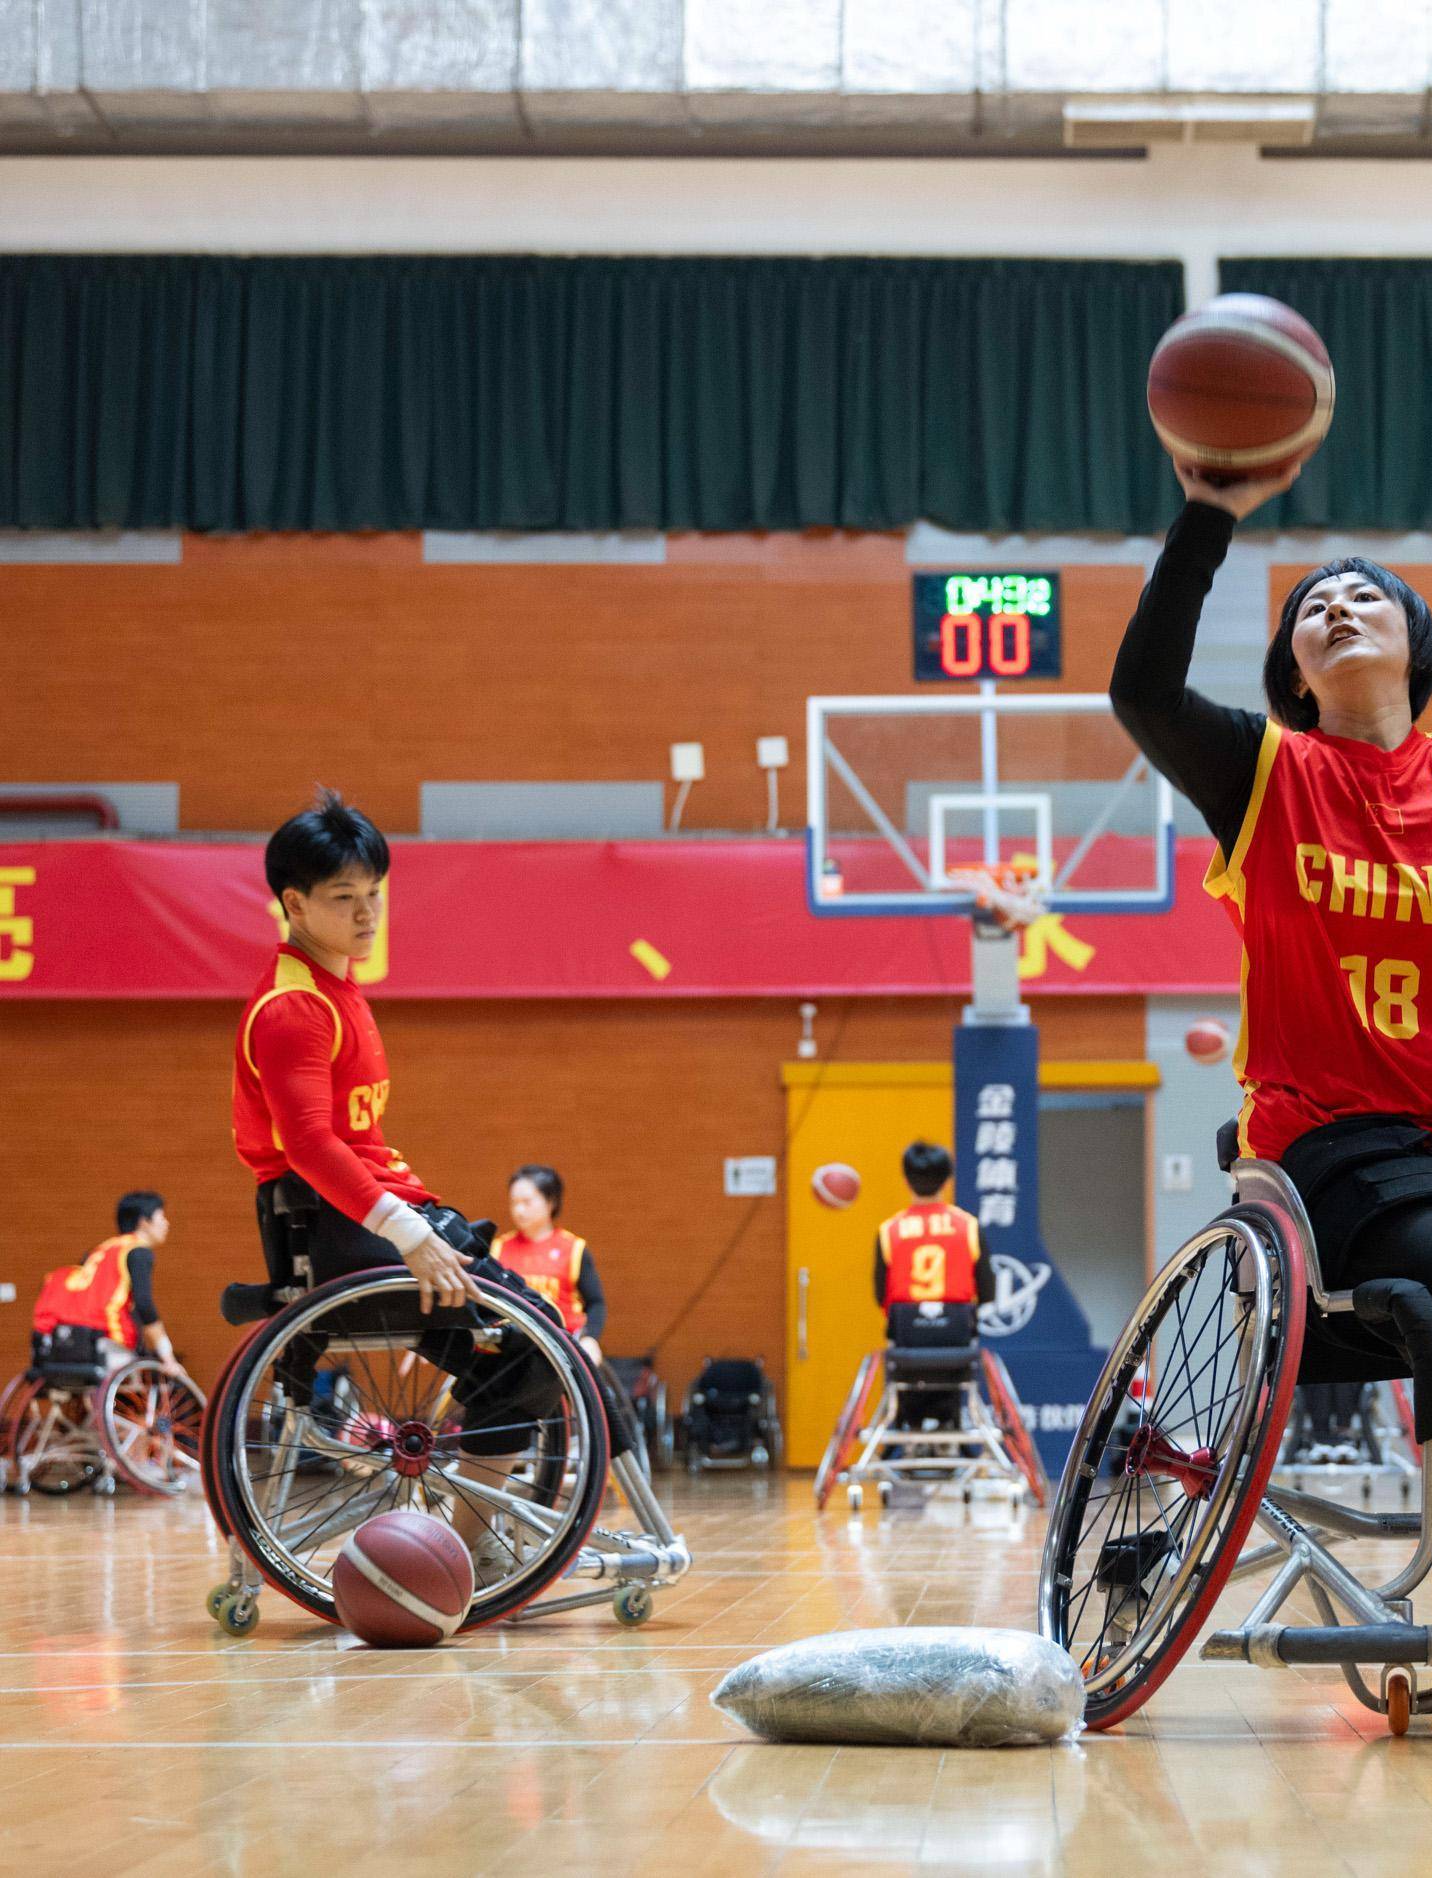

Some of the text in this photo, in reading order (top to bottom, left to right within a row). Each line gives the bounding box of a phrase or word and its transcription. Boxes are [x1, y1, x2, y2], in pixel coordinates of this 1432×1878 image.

[940, 612, 1030, 677] 00
[1340, 954, 1420, 1040] 18
[909, 1244, 946, 1301] 9
